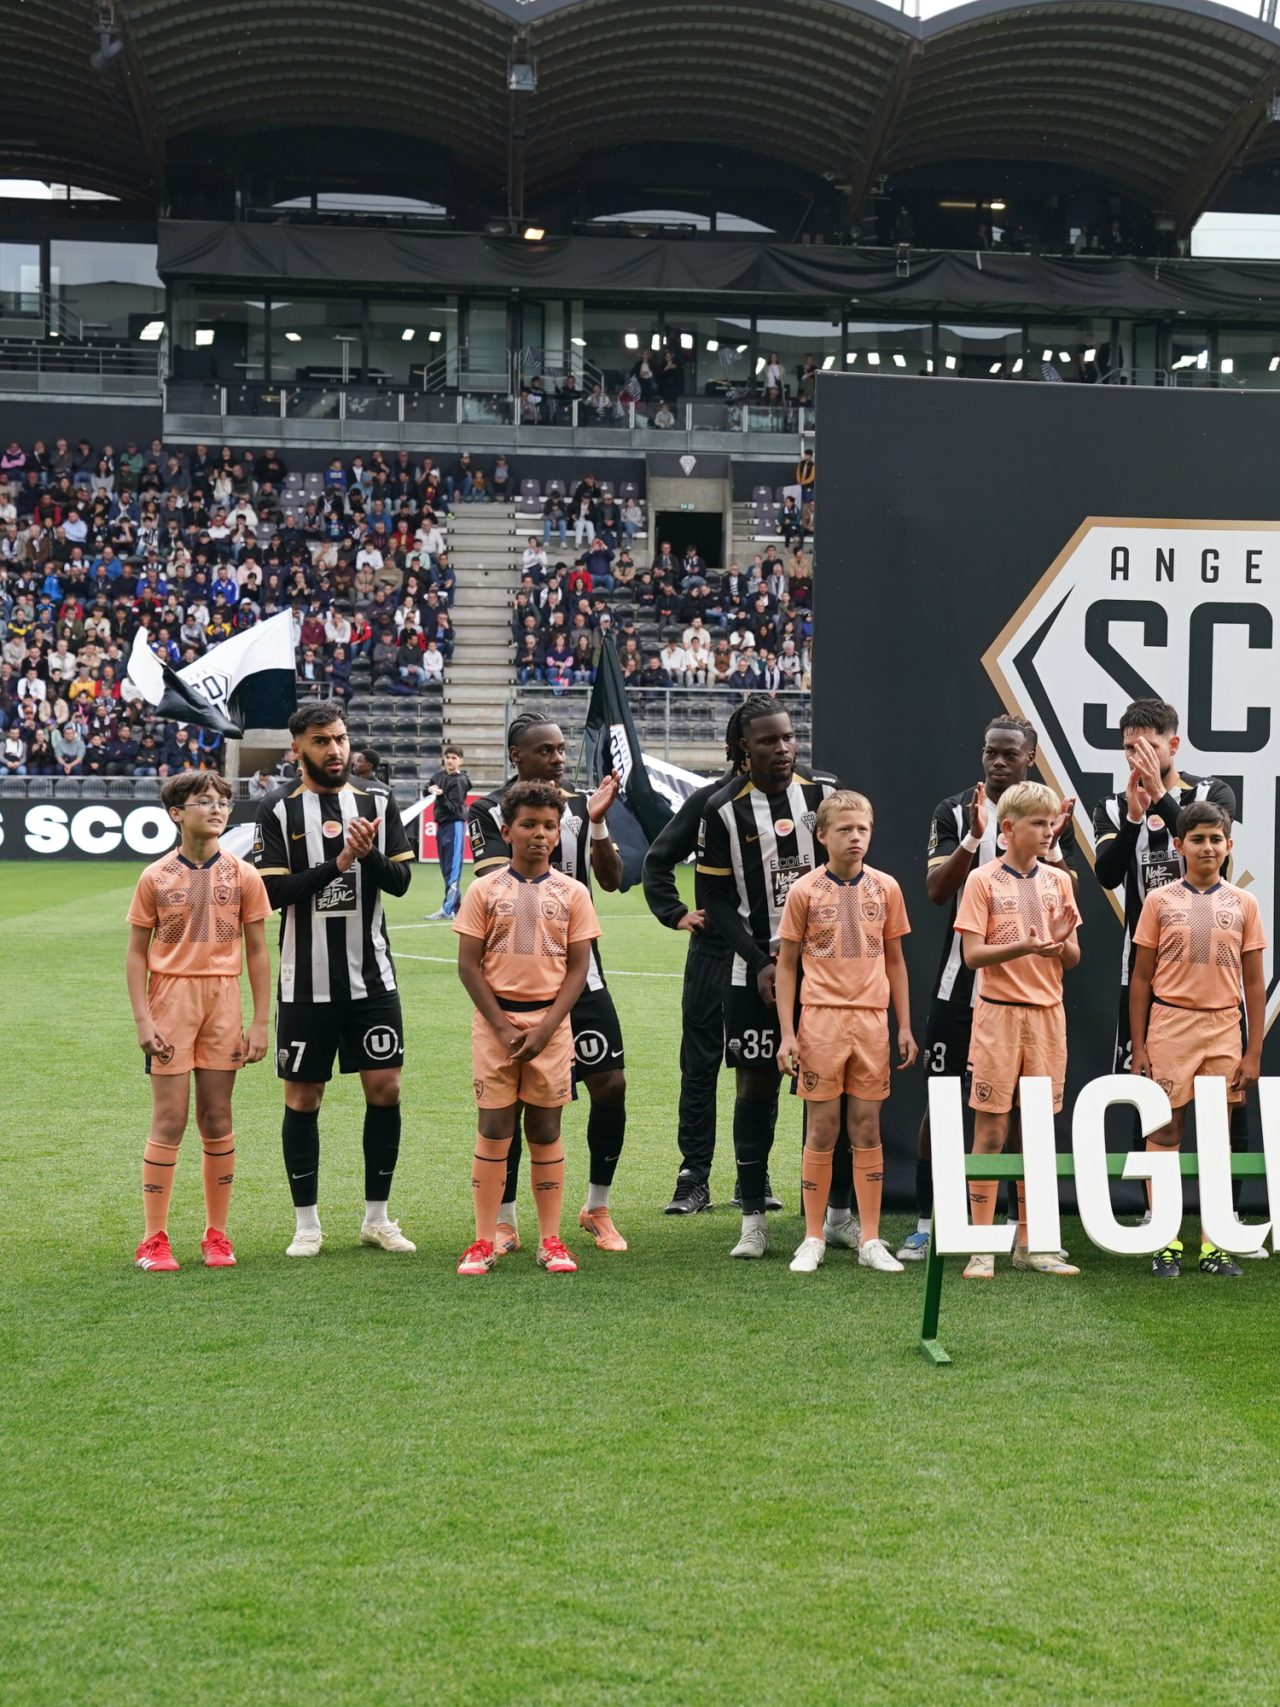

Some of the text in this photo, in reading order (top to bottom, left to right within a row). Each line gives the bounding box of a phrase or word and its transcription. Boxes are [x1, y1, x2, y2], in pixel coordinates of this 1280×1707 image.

[25, 804, 178, 854] SCO
[770, 854, 811, 870] ECOLE
[290, 1041, 307, 1073] 7
[743, 1030, 774, 1059] 35
[931, 1042, 947, 1072] 3
